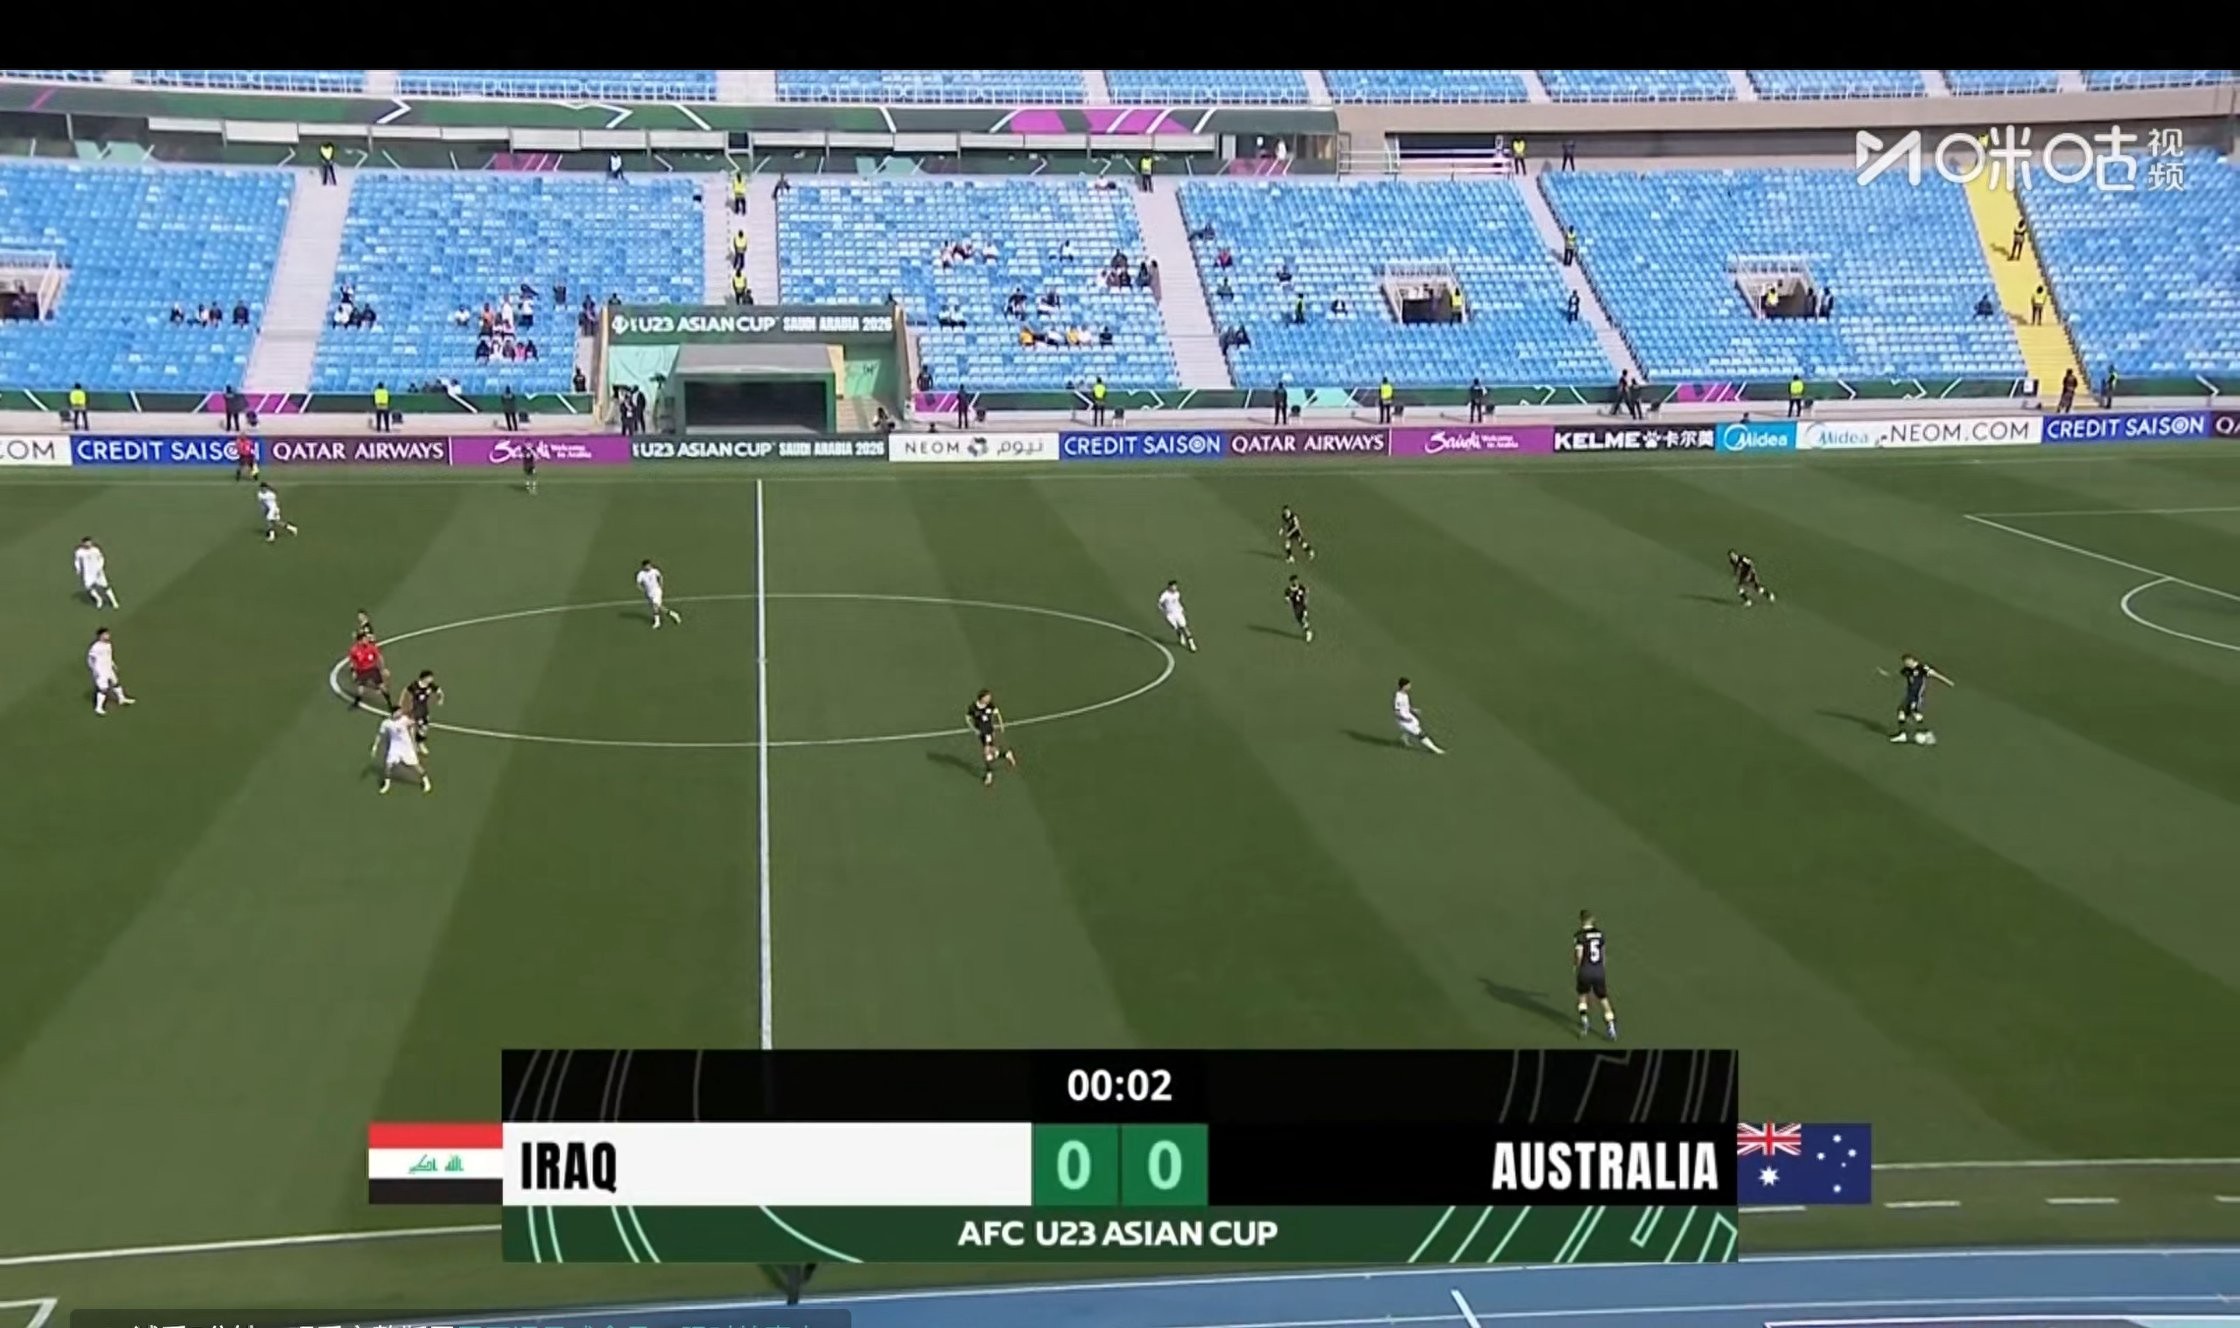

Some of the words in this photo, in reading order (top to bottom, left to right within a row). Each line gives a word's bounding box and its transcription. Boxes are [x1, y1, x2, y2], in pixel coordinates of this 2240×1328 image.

[638, 316, 675, 332] U23
[676, 316, 735, 332] ASIAN
[736, 316, 776, 332] CUP
[783, 316, 817, 332] SAUDI
[819, 316, 859, 332] ARABIA
[862, 316, 892, 332] 2026
[1890, 421, 2029, 442] NEOM.COM
[2047, 418, 2121, 438] CREDIT
[2125, 416, 2205, 436] SAISON
[1064, 436, 1137, 456] CREDIT
[1143, 435, 1221, 455] SAISON
[1231, 434, 1296, 453] QATAR
[1304, 434, 1384, 452] AIRWAYS
[1554, 431, 1641, 450] KELME
[1734, 431, 1788, 448] Midea
[1817, 429, 1869, 445] Midea
[0, 440, 55, 460] OM
[77, 441, 163, 460] CREDIT
[273, 441, 347, 460] QATAR
[355, 441, 445, 460] AIRWAYS
[640, 442, 675, 458] U23
[677, 442, 733, 457] ASIAN
[734, 442, 773, 457] CUP
[779, 442, 811, 457] SAUDI
[814, 441, 853, 456] ARABIA
[855, 441, 885, 456] 2026
[905, 441, 960, 455] NEOM
[997, 439, 1044, 456] نيوم
